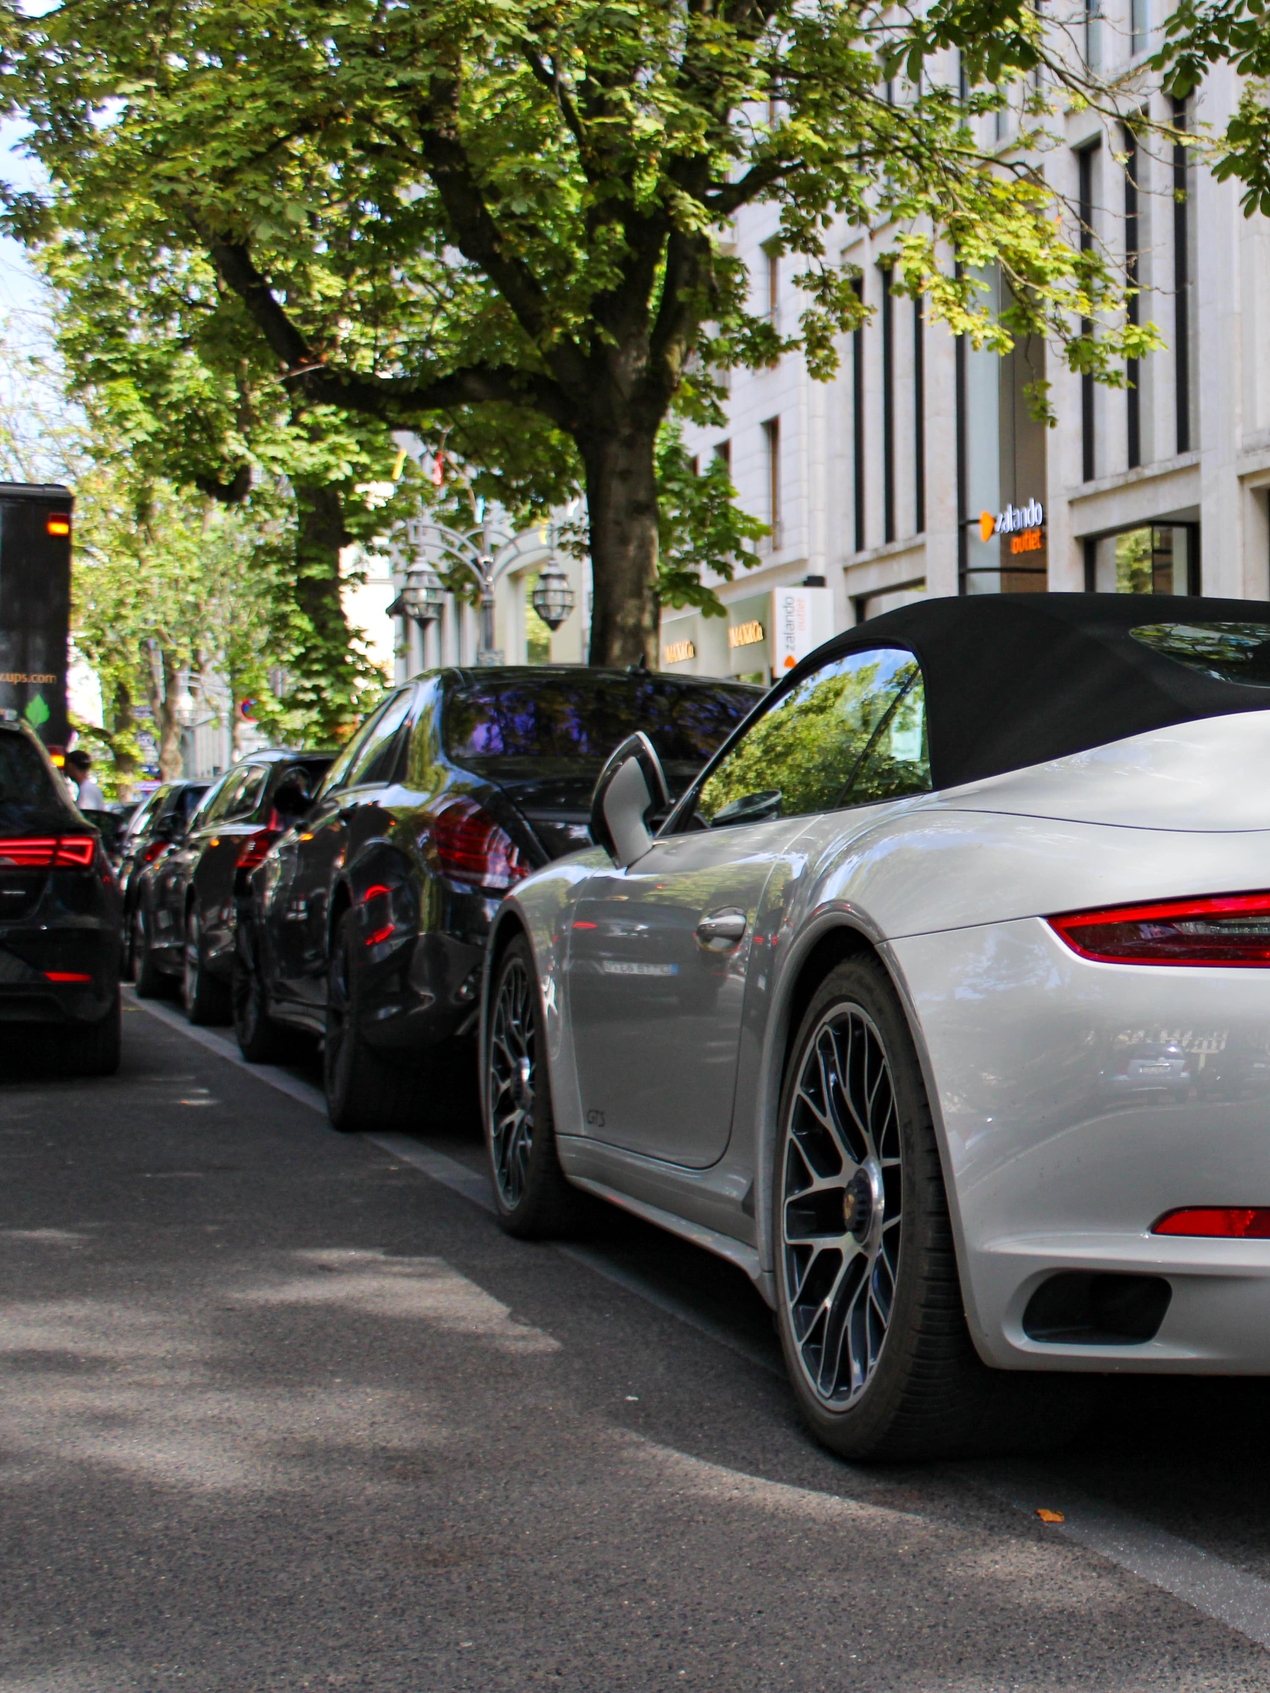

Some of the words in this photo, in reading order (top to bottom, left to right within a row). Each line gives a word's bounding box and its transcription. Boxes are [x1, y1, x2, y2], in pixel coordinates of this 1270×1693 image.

[994, 497, 1043, 533] zalando
[1011, 527, 1042, 554] outlet
[783, 596, 796, 651] zalando
